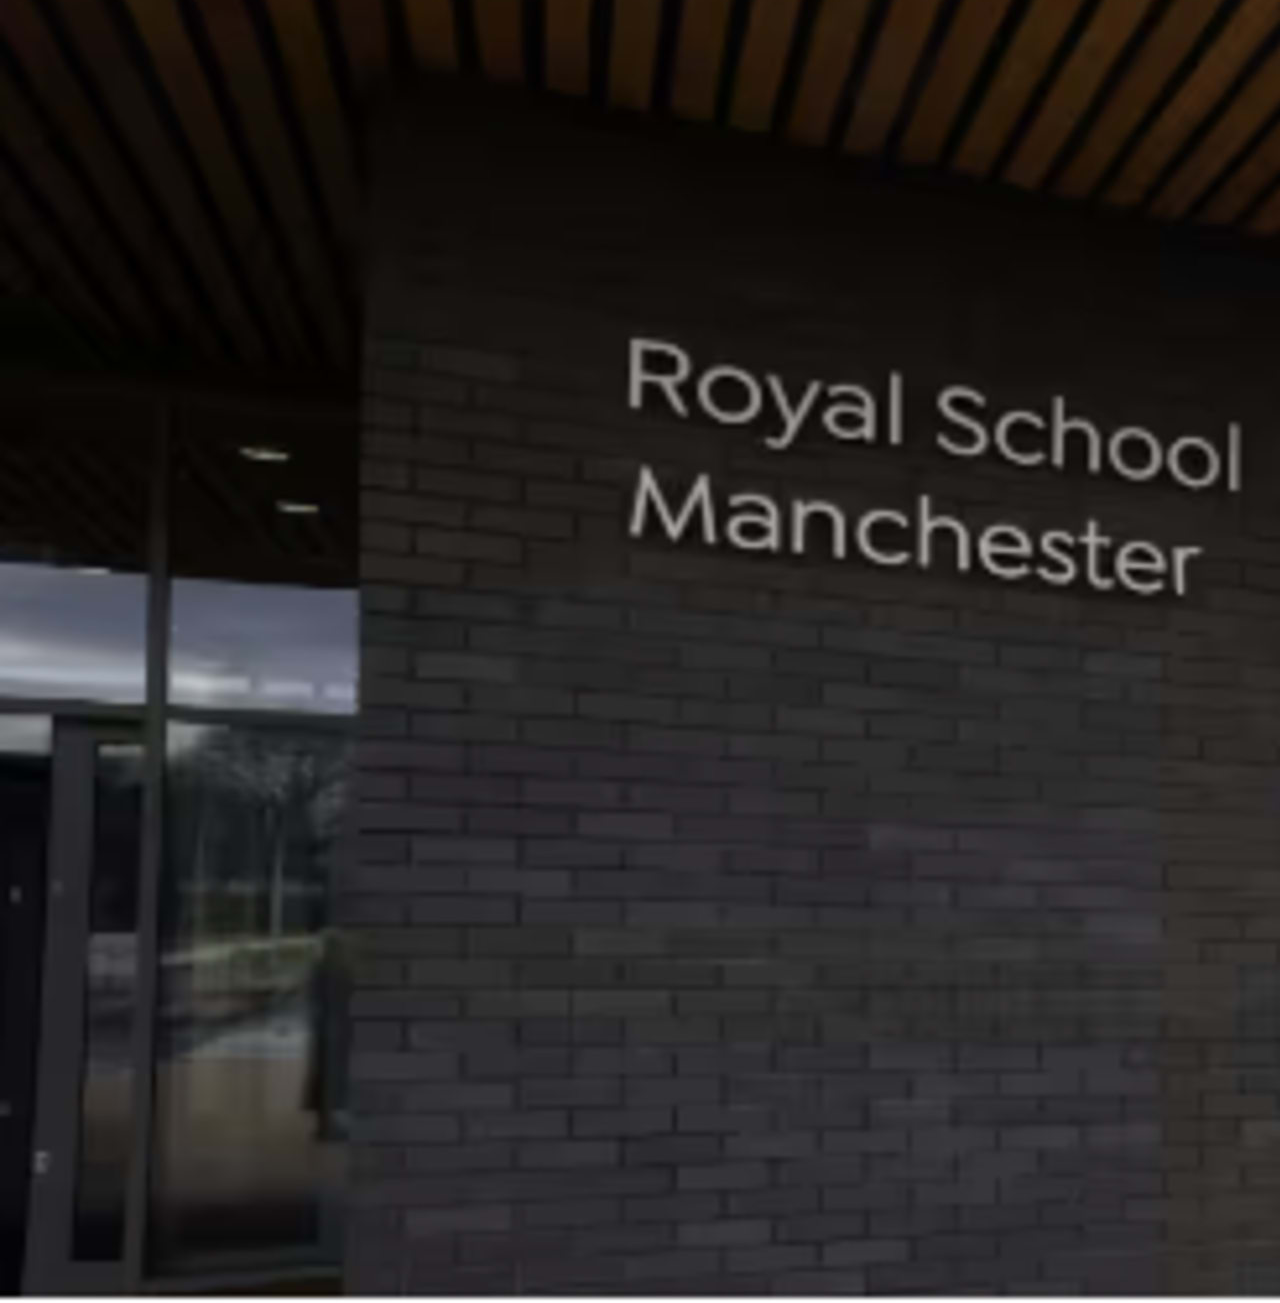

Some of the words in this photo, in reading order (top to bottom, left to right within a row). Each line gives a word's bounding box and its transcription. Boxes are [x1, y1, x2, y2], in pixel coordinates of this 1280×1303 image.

[627, 337, 903, 450] Royal
[935, 386, 1242, 492] School
[628, 464, 1203, 596] Manchester
